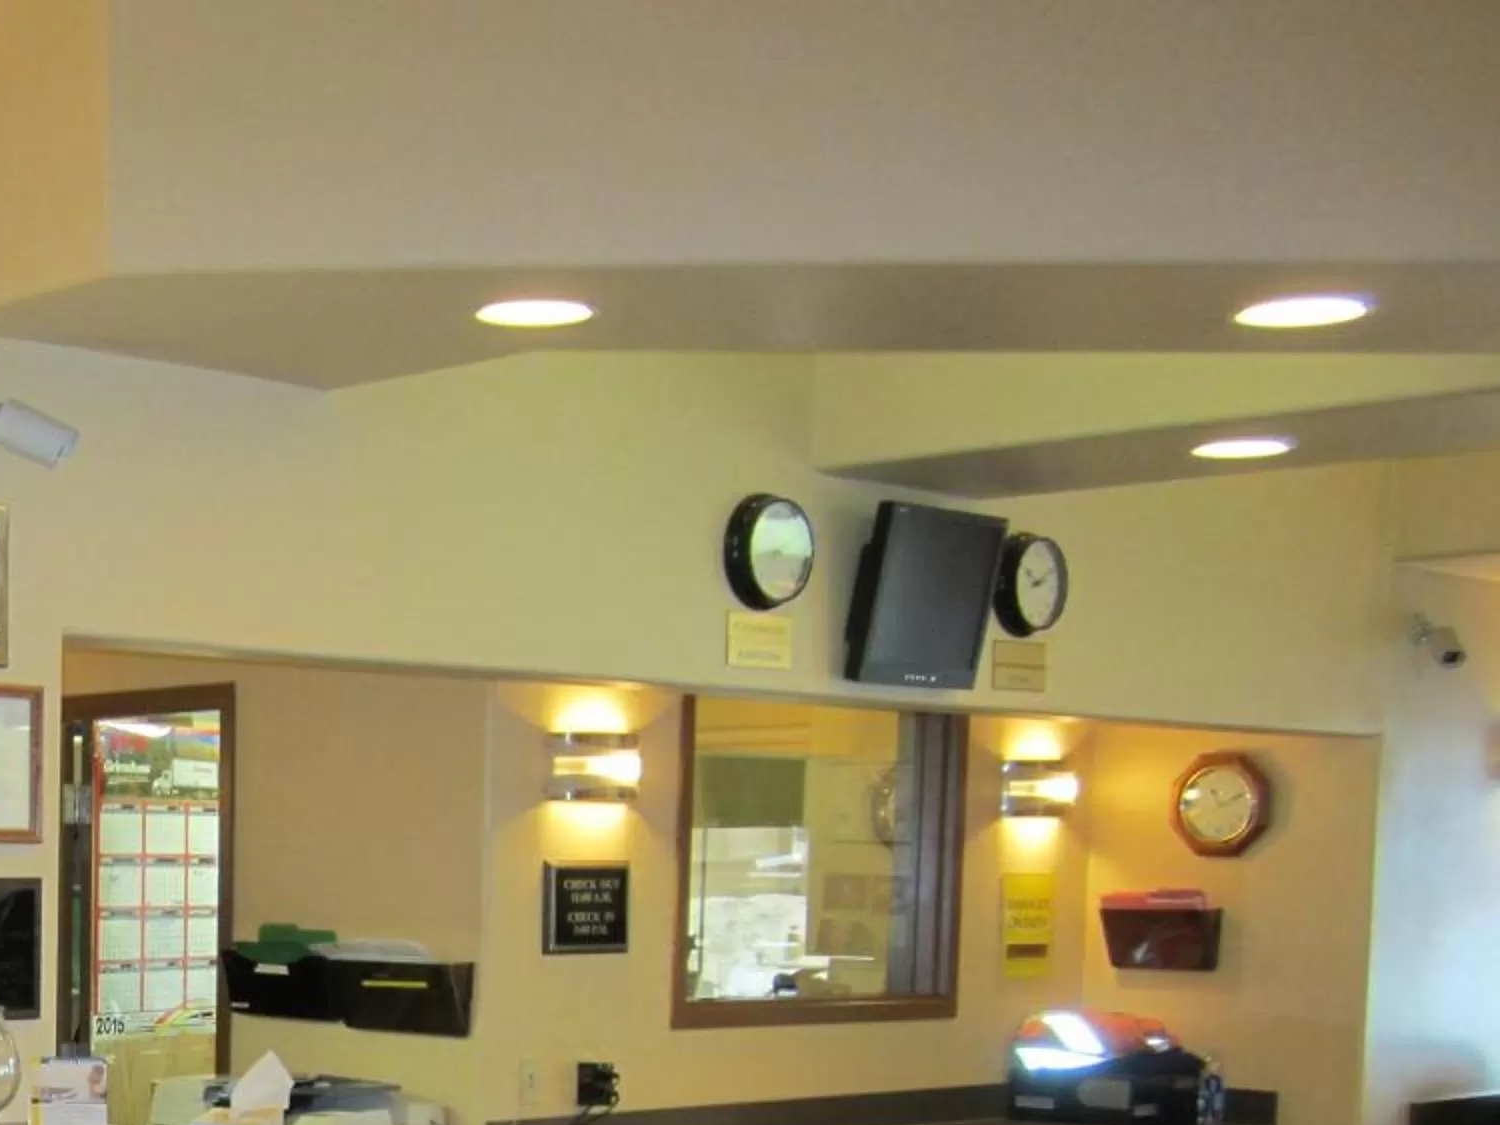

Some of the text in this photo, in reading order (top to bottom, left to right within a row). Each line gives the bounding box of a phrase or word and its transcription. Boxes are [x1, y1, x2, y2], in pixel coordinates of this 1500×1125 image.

[562, 879, 597, 890] CHECK
[567, 911, 601, 922] CHECK
[95, 1016, 125, 1035] 2015
